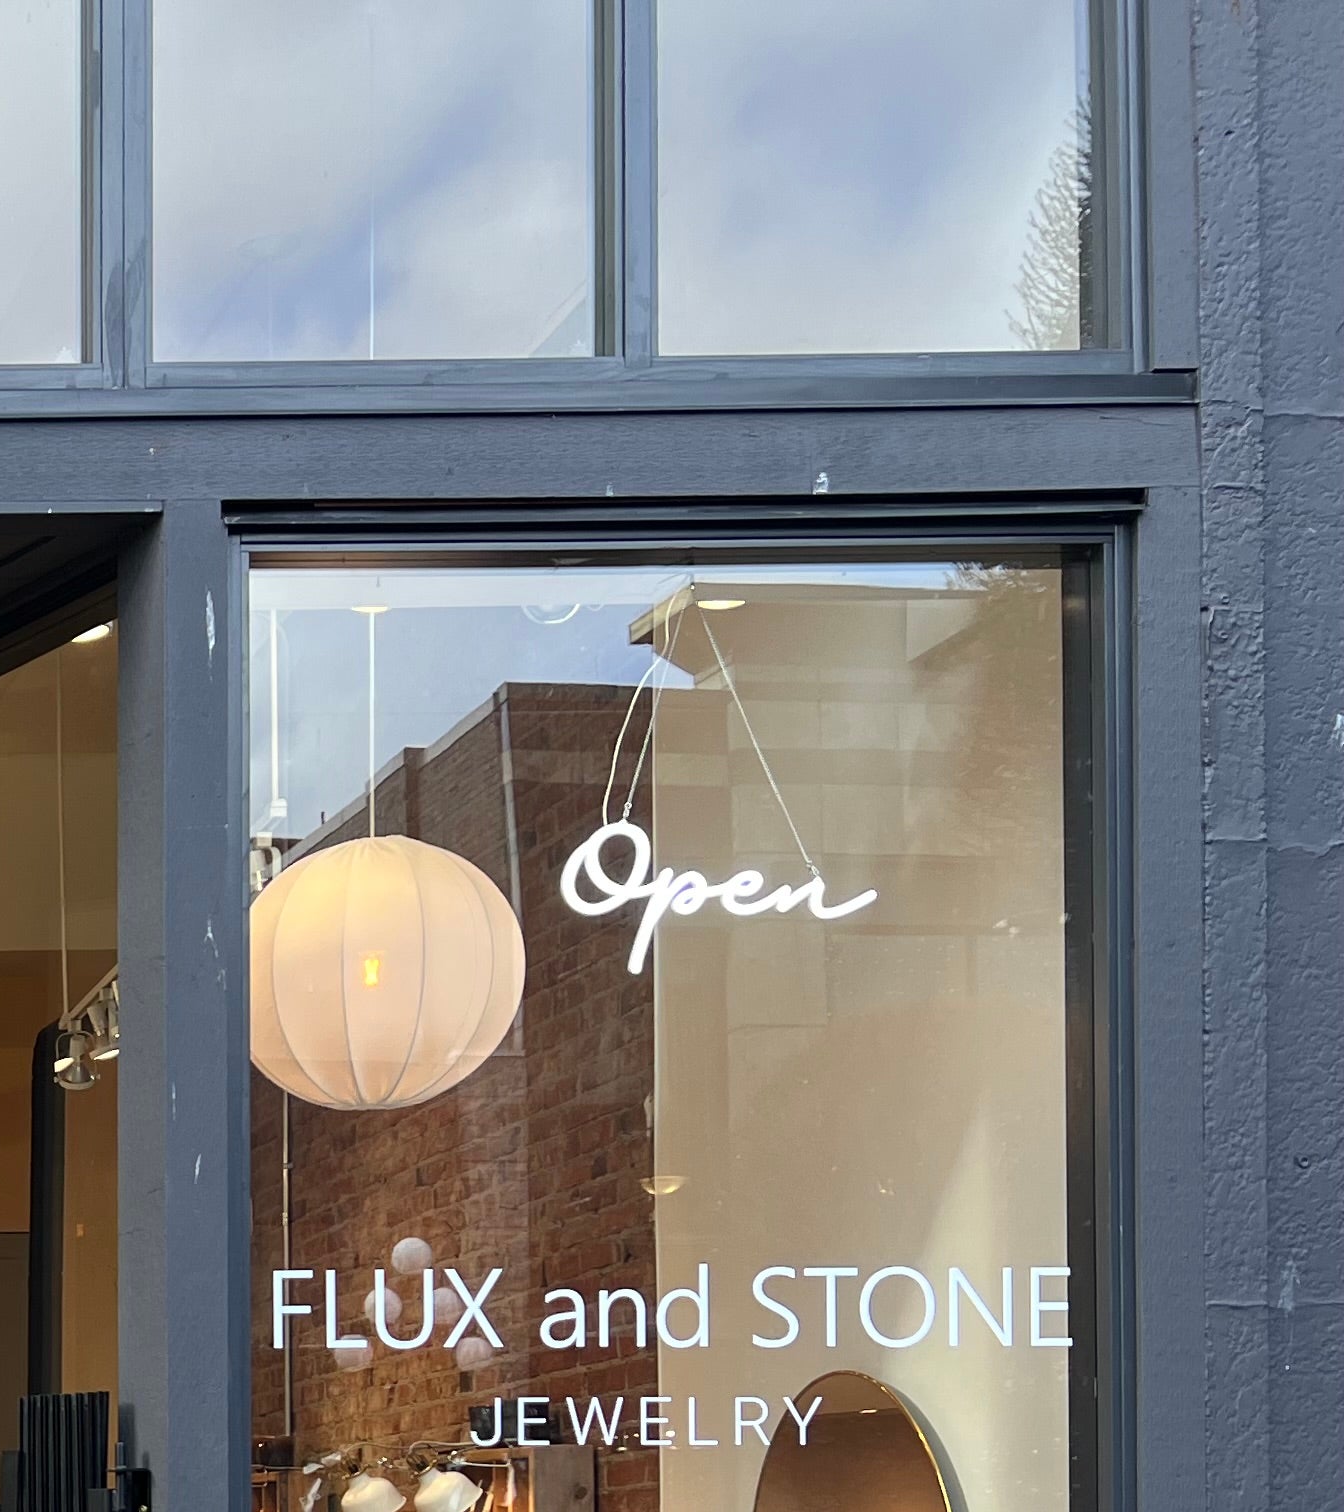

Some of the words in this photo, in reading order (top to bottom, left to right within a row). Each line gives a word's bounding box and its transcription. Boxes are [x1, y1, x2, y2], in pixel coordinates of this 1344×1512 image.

[560, 818, 878, 976] Open
[272, 1268, 504, 1349] FLUX
[540, 1263, 709, 1349] and
[752, 1265, 1074, 1348] STONE
[470, 1396, 824, 1447] JEWELRY
